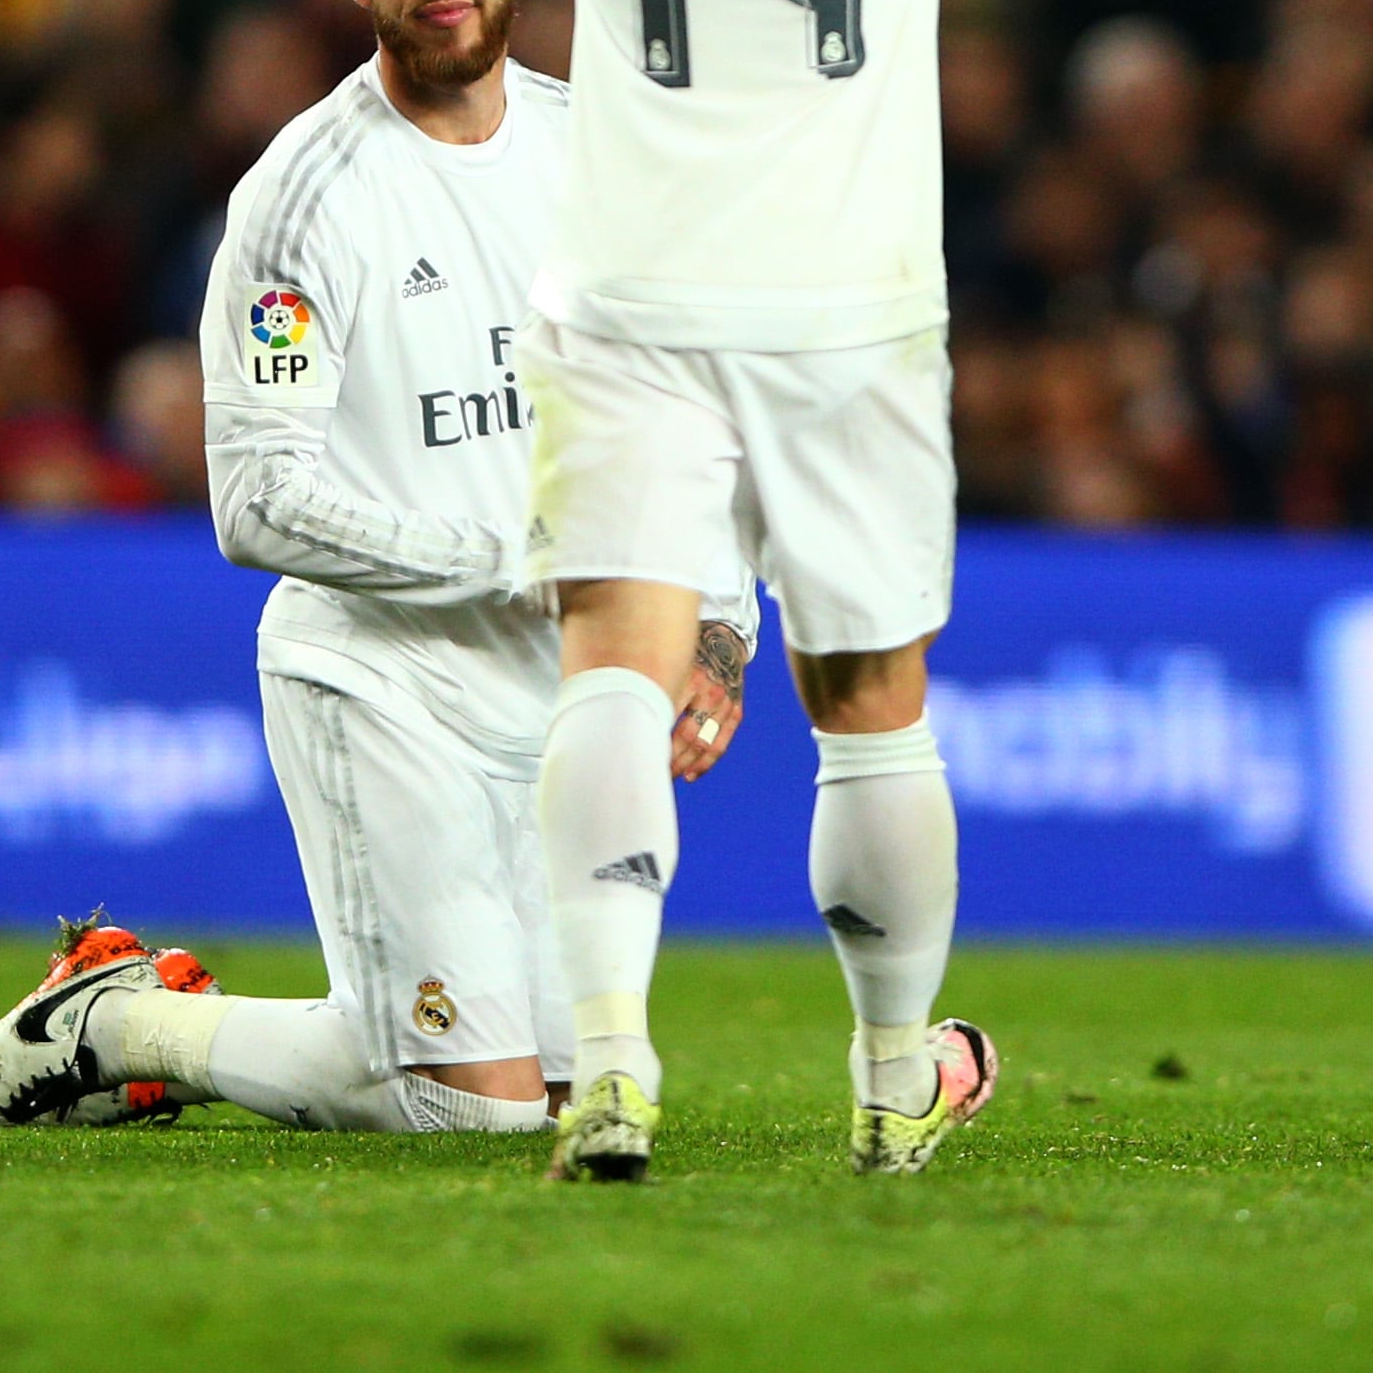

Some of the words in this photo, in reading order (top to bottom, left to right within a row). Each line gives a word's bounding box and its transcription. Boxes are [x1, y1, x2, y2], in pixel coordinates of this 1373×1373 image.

[402, 278, 449, 299] adidas
[254, 354, 309, 384] LFP
[417, 371, 533, 448] Emi
